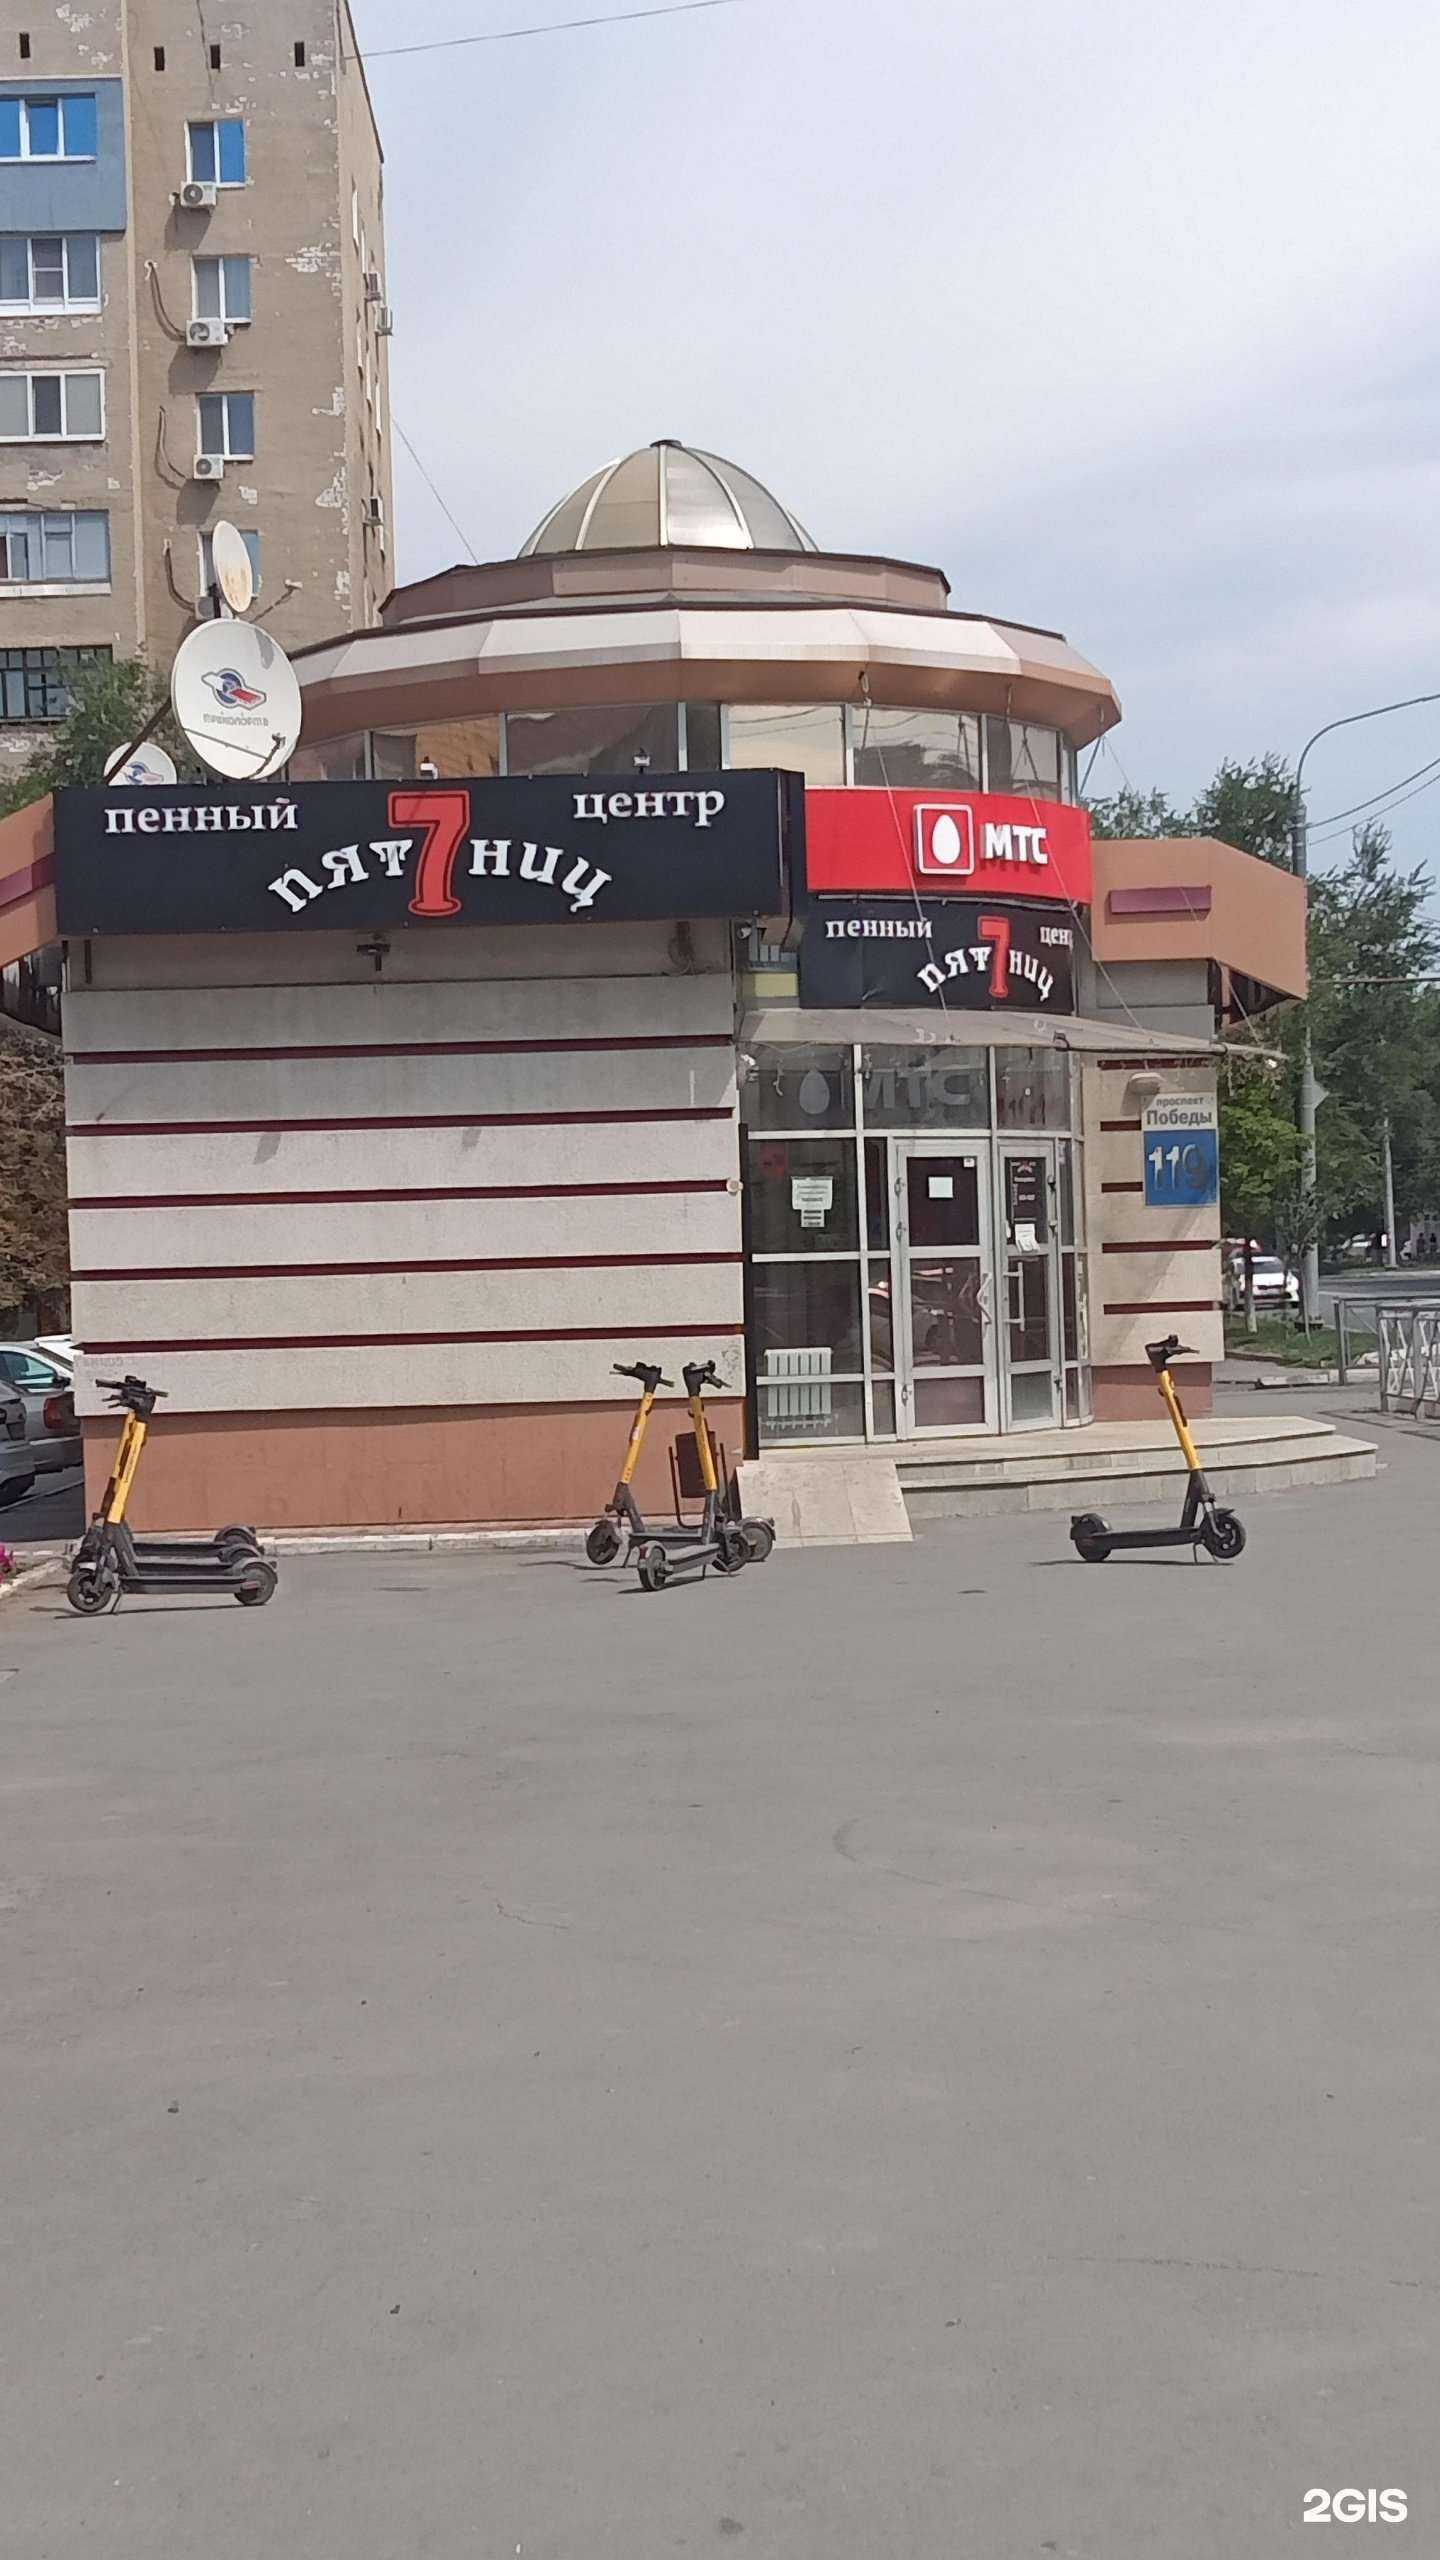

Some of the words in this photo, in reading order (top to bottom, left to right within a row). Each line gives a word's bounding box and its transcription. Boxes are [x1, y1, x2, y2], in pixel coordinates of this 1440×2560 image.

[104, 797, 299, 834] пенный
[572, 790, 725, 827] центр
[982, 822, 1048, 865] МТС
[825, 917, 933, 939] пенный
[1039, 926, 1074, 949] цен
[1146, 1109, 1212, 1126] Победы
[1156, 1097, 1204, 1108] проспект
